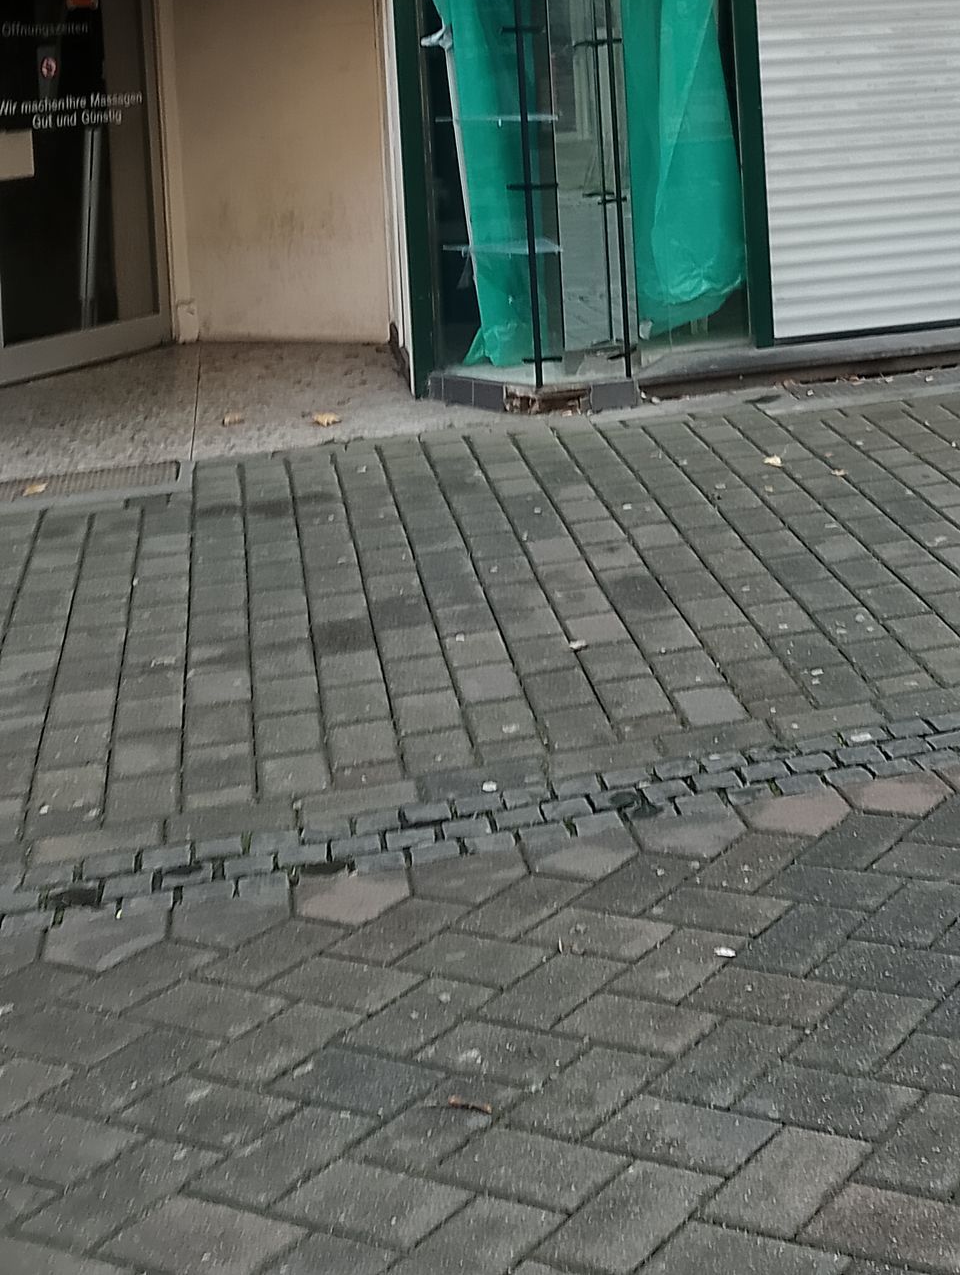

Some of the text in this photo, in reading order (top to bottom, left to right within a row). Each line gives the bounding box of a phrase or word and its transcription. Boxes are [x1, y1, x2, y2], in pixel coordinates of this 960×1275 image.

[90, 90, 143, 109] Massagen
[32, 111, 53, 130] Gut
[56, 109, 77, 128] und
